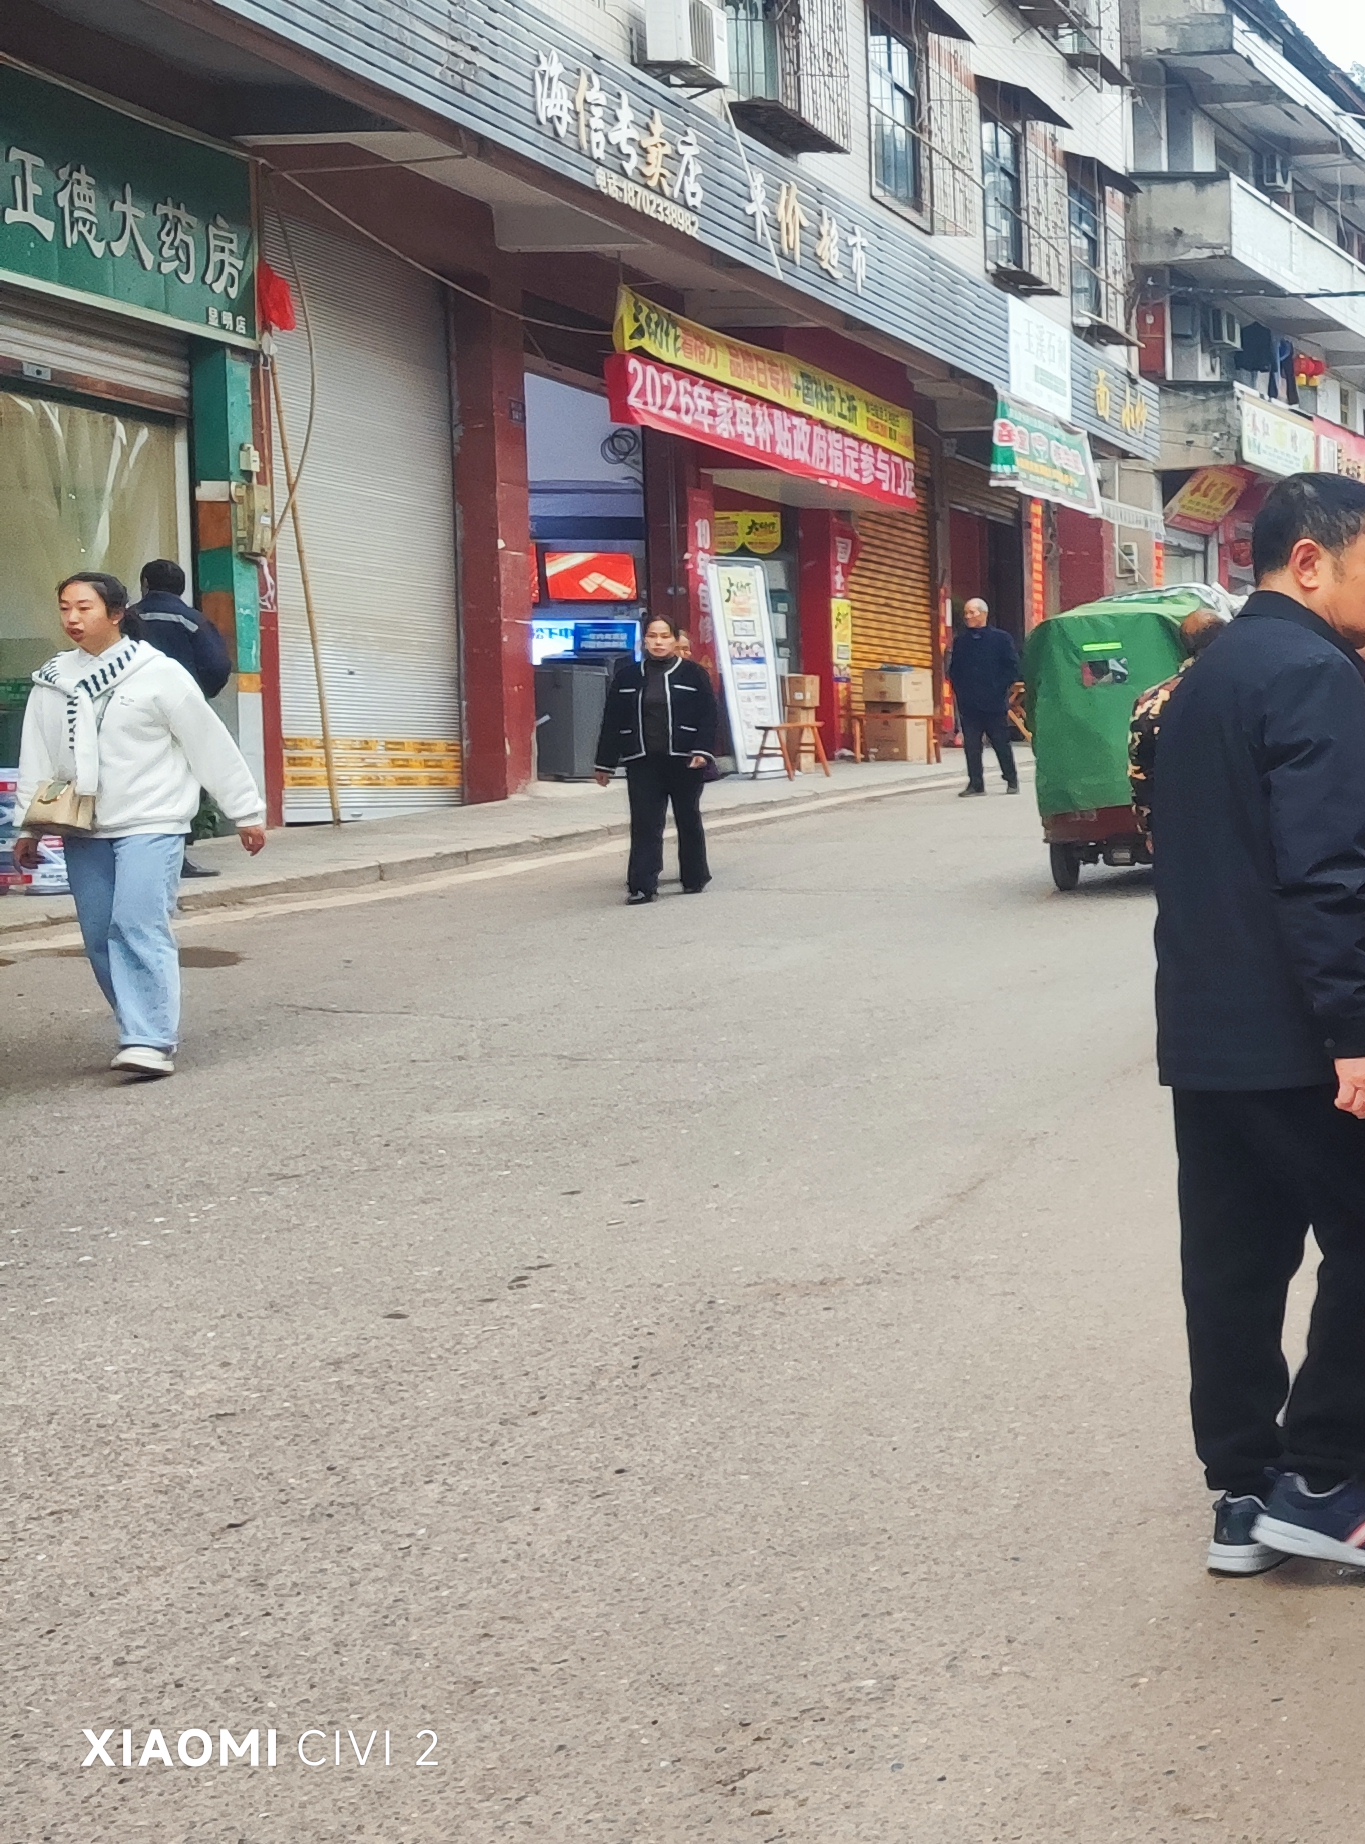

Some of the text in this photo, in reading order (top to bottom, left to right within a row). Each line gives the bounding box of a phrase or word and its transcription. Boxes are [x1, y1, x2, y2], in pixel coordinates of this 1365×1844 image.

[534, 49, 703, 209] 海信专卖店
[4, 146, 245, 299] 正德大药房
